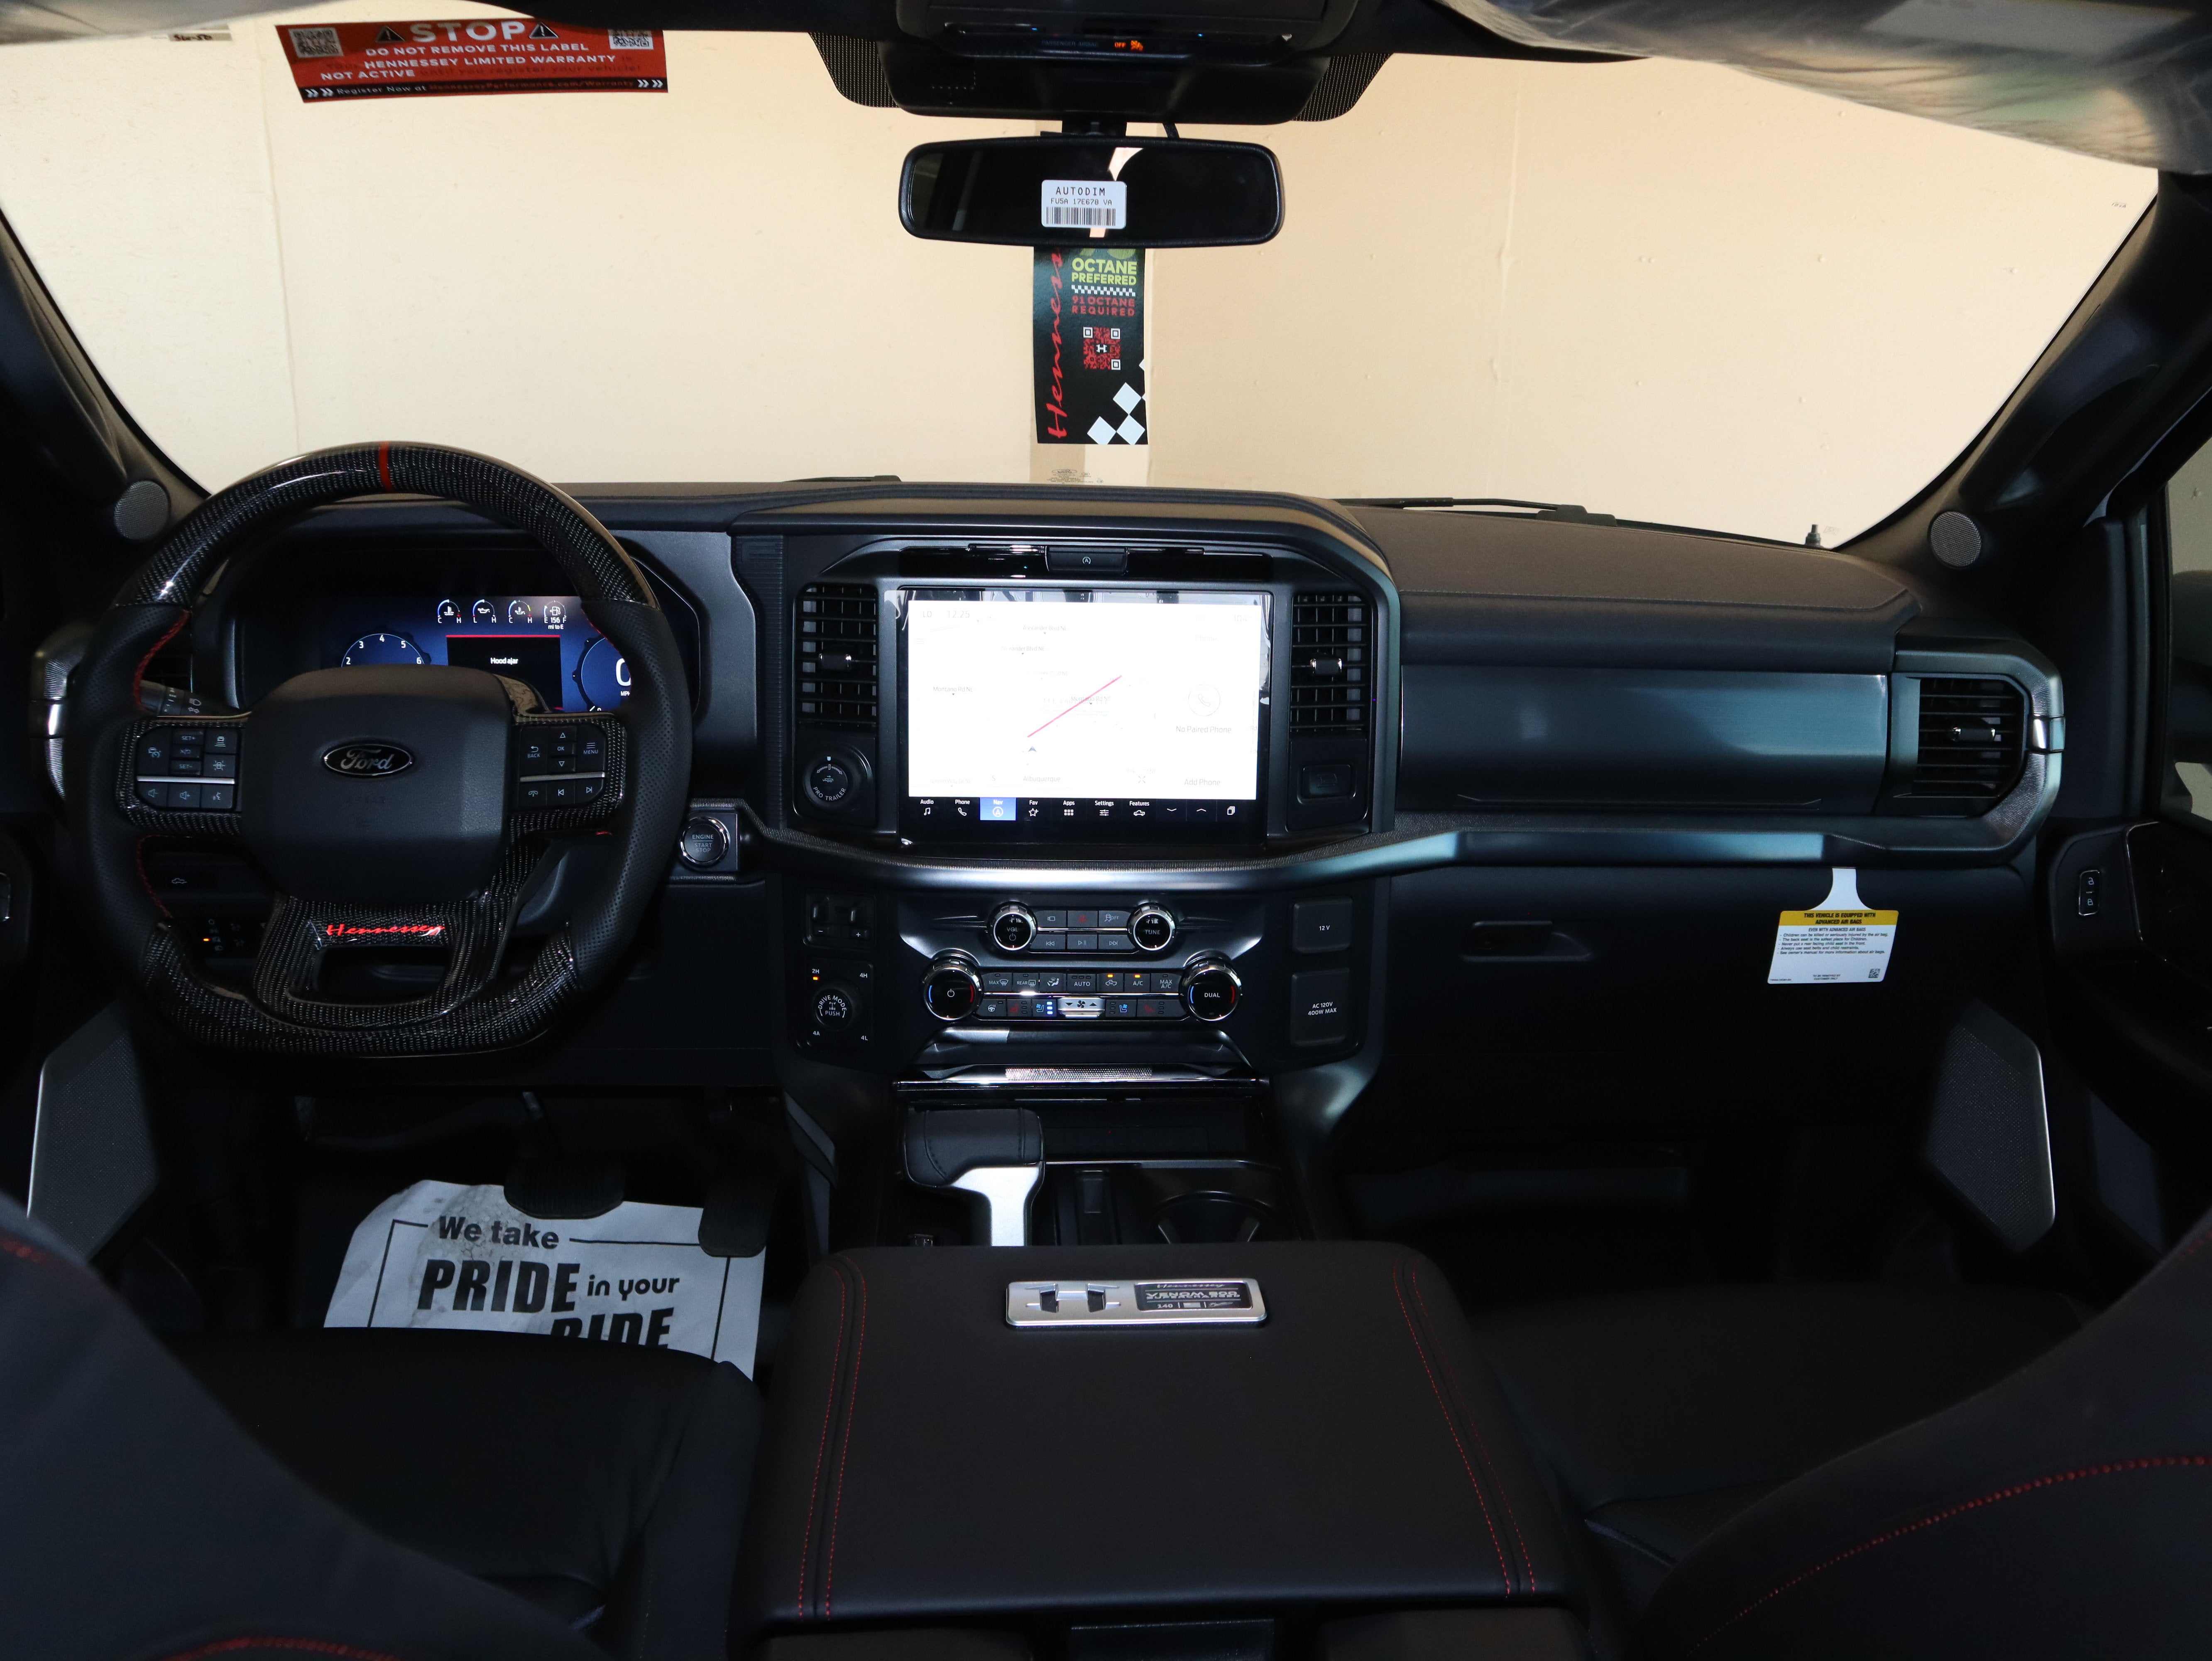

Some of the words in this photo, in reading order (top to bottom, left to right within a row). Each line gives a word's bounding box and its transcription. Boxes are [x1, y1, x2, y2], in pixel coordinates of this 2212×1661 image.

[409, 21, 526, 42] STOP
[394, 47, 426, 55] NOT
[431, 44, 496, 54] REMOVE
[500, 44, 536, 52] THIS
[541, 43, 589, 51] LABEL
[364, 58, 458, 70] HENNESSEY
[465, 56, 526, 65] LIMITED
[530, 55, 616, 64] WARRANTY
[321, 72, 353, 81] NOT
[358, 69, 415, 79] ACTIVE
[337, 87, 382, 96] Register
[1055, 186, 1105, 196] AUTODIM
[1072, 257, 1138, 275] OCTANE
[1071, 272, 1137, 286] PREFERRED
[1072, 295, 1085, 304] 91
[1087, 296, 1135, 307] OCTANE
[1071, 305, 1135, 317] REQUIRED
[1045, 248, 1068, 439] Henness
[340, 748, 394, 769] Ford
[813, 786, 823, 798] PRO
[825, 788, 847, 801] TRAILER
[818, 995, 831, 1009] DRIVE
[832, 995, 847, 1011] MODE
[439, 1215, 482, 1242] We
[491, 1220, 559, 1249] take
[417, 1259, 580, 1313] PRIDE
[587, 1274, 610, 1296] in
[618, 1277, 680, 1301] your
